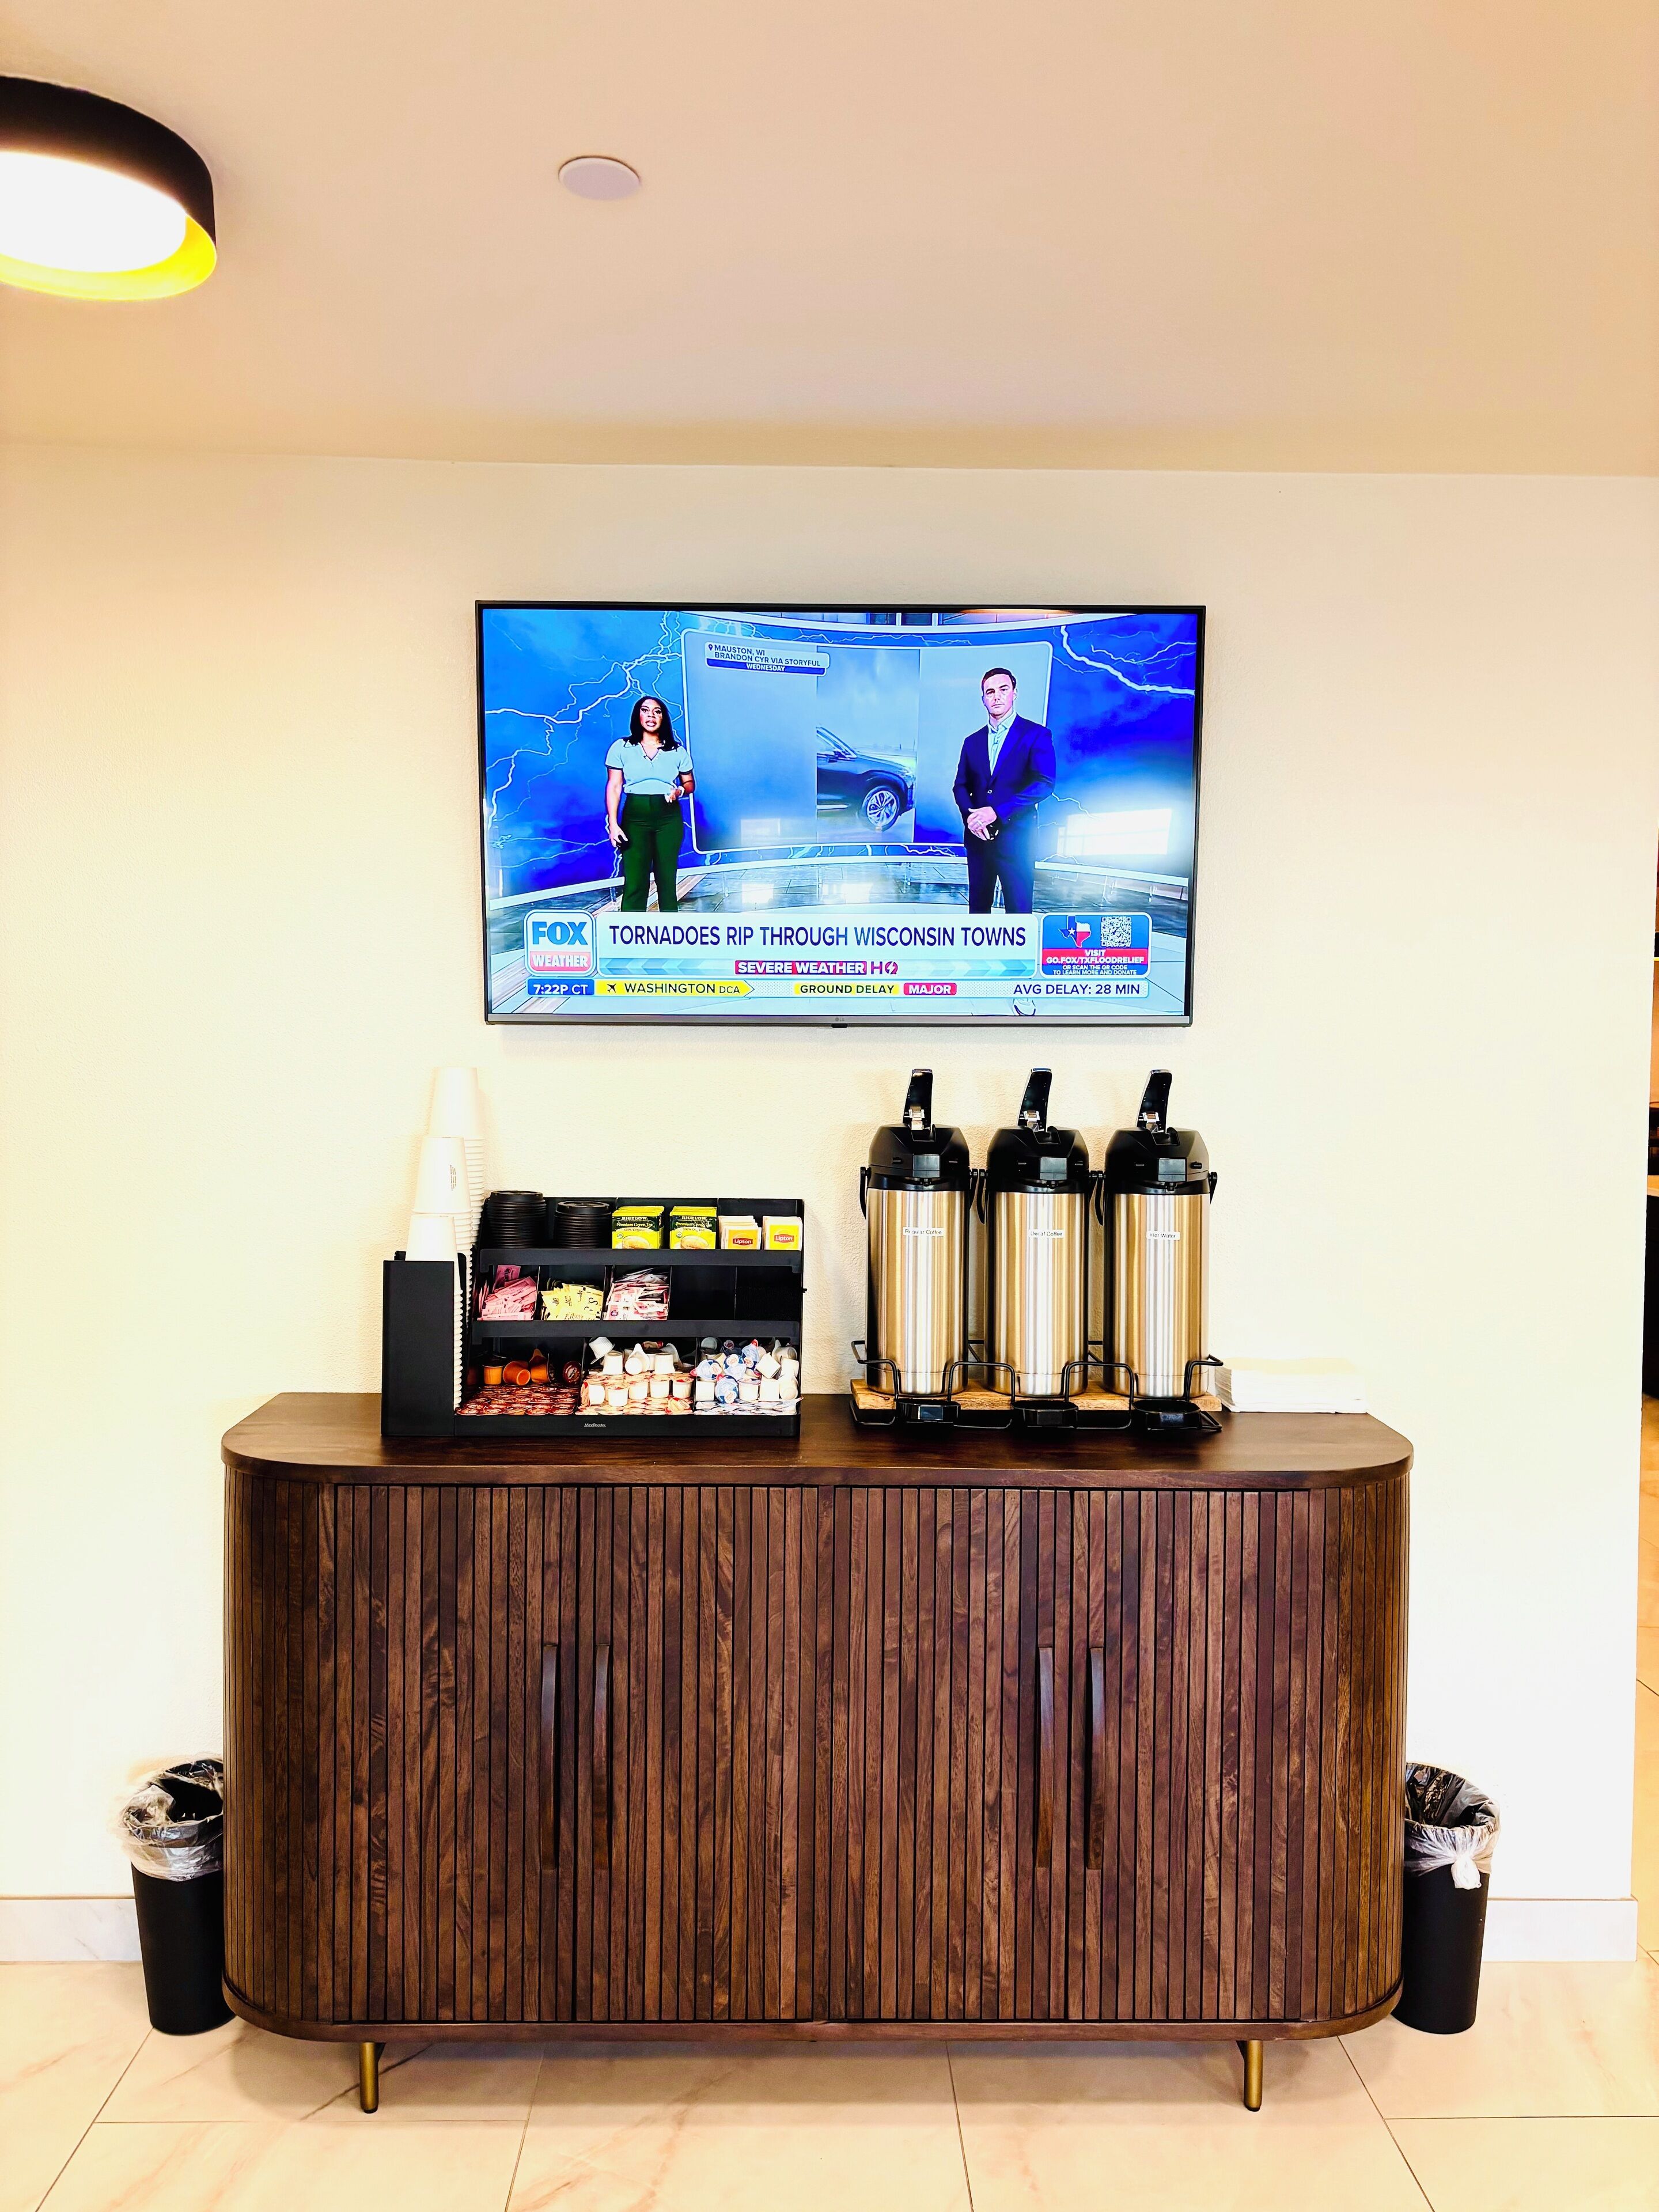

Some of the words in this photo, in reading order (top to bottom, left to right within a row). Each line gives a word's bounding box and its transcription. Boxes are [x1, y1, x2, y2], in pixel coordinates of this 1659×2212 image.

[714, 645, 754, 656] MAUSTON,
[715, 652, 752, 662] BRANDON
[785, 658, 821, 666] STORYFUL
[746, 663, 786, 672] WEDNESDAY
[532, 922, 588, 945] FOX
[609, 925, 720, 945] TORNADOES
[727, 926, 753, 945] RIP
[760, 926, 848, 946] THROUGH
[854, 927, 954, 946] WISCONSIN
[961, 927, 1026, 946] TOWNS
[532, 955, 588, 967] WEATHER
[738, 962, 792, 973] SEVERE
[795, 962, 865, 974] WEATHER
[533, 984, 568, 994] 7:22P
[571, 984, 588, 995] CT
[624, 983, 715, 993] WASHINGTON
[800, 985, 852, 993] GROUND
[857, 985, 894, 994] DELAY
[908, 984, 951, 994] MAJOR
[1013, 984, 1041, 994] AVG
[1046, 984, 1091, 994] DELAY:
[1095, 984, 1111, 994] 28
[1116, 984, 1139, 994] MIN
